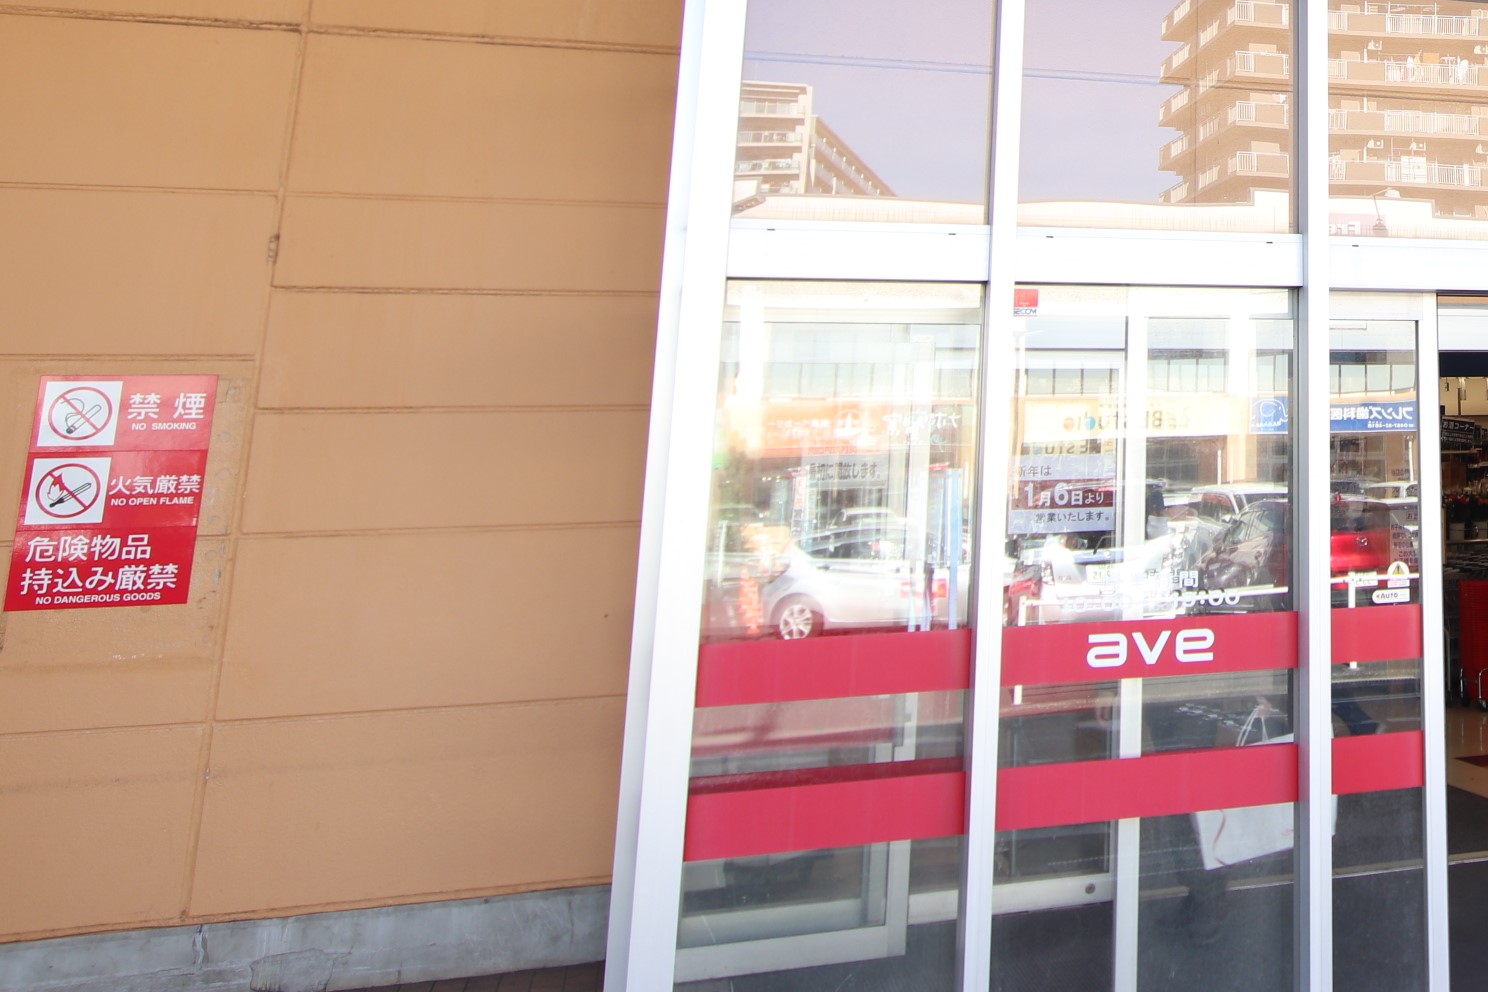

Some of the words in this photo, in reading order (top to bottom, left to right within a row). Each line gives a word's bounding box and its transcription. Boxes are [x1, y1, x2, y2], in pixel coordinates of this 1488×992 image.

[131, 422, 147, 431] NO
[151, 422, 197, 430] SMOKING
[108, 474, 202, 496] 火気厳禁
[1024, 481, 1104, 507] 1月6日より
[110, 498, 126, 506] NO
[129, 497, 157, 506] OPEN
[159, 496, 194, 505] FLAME
[1035, 511, 1110, 523] 営業いたします。
[25, 533, 152, 563] 危険物品
[20, 563, 179, 595] 持込み厳禁
[35, 596, 52, 605] NO
[54, 593, 120, 604] DANGEROUS
[123, 592, 161, 602] GOODS
[1086, 627, 1216, 669] ave
